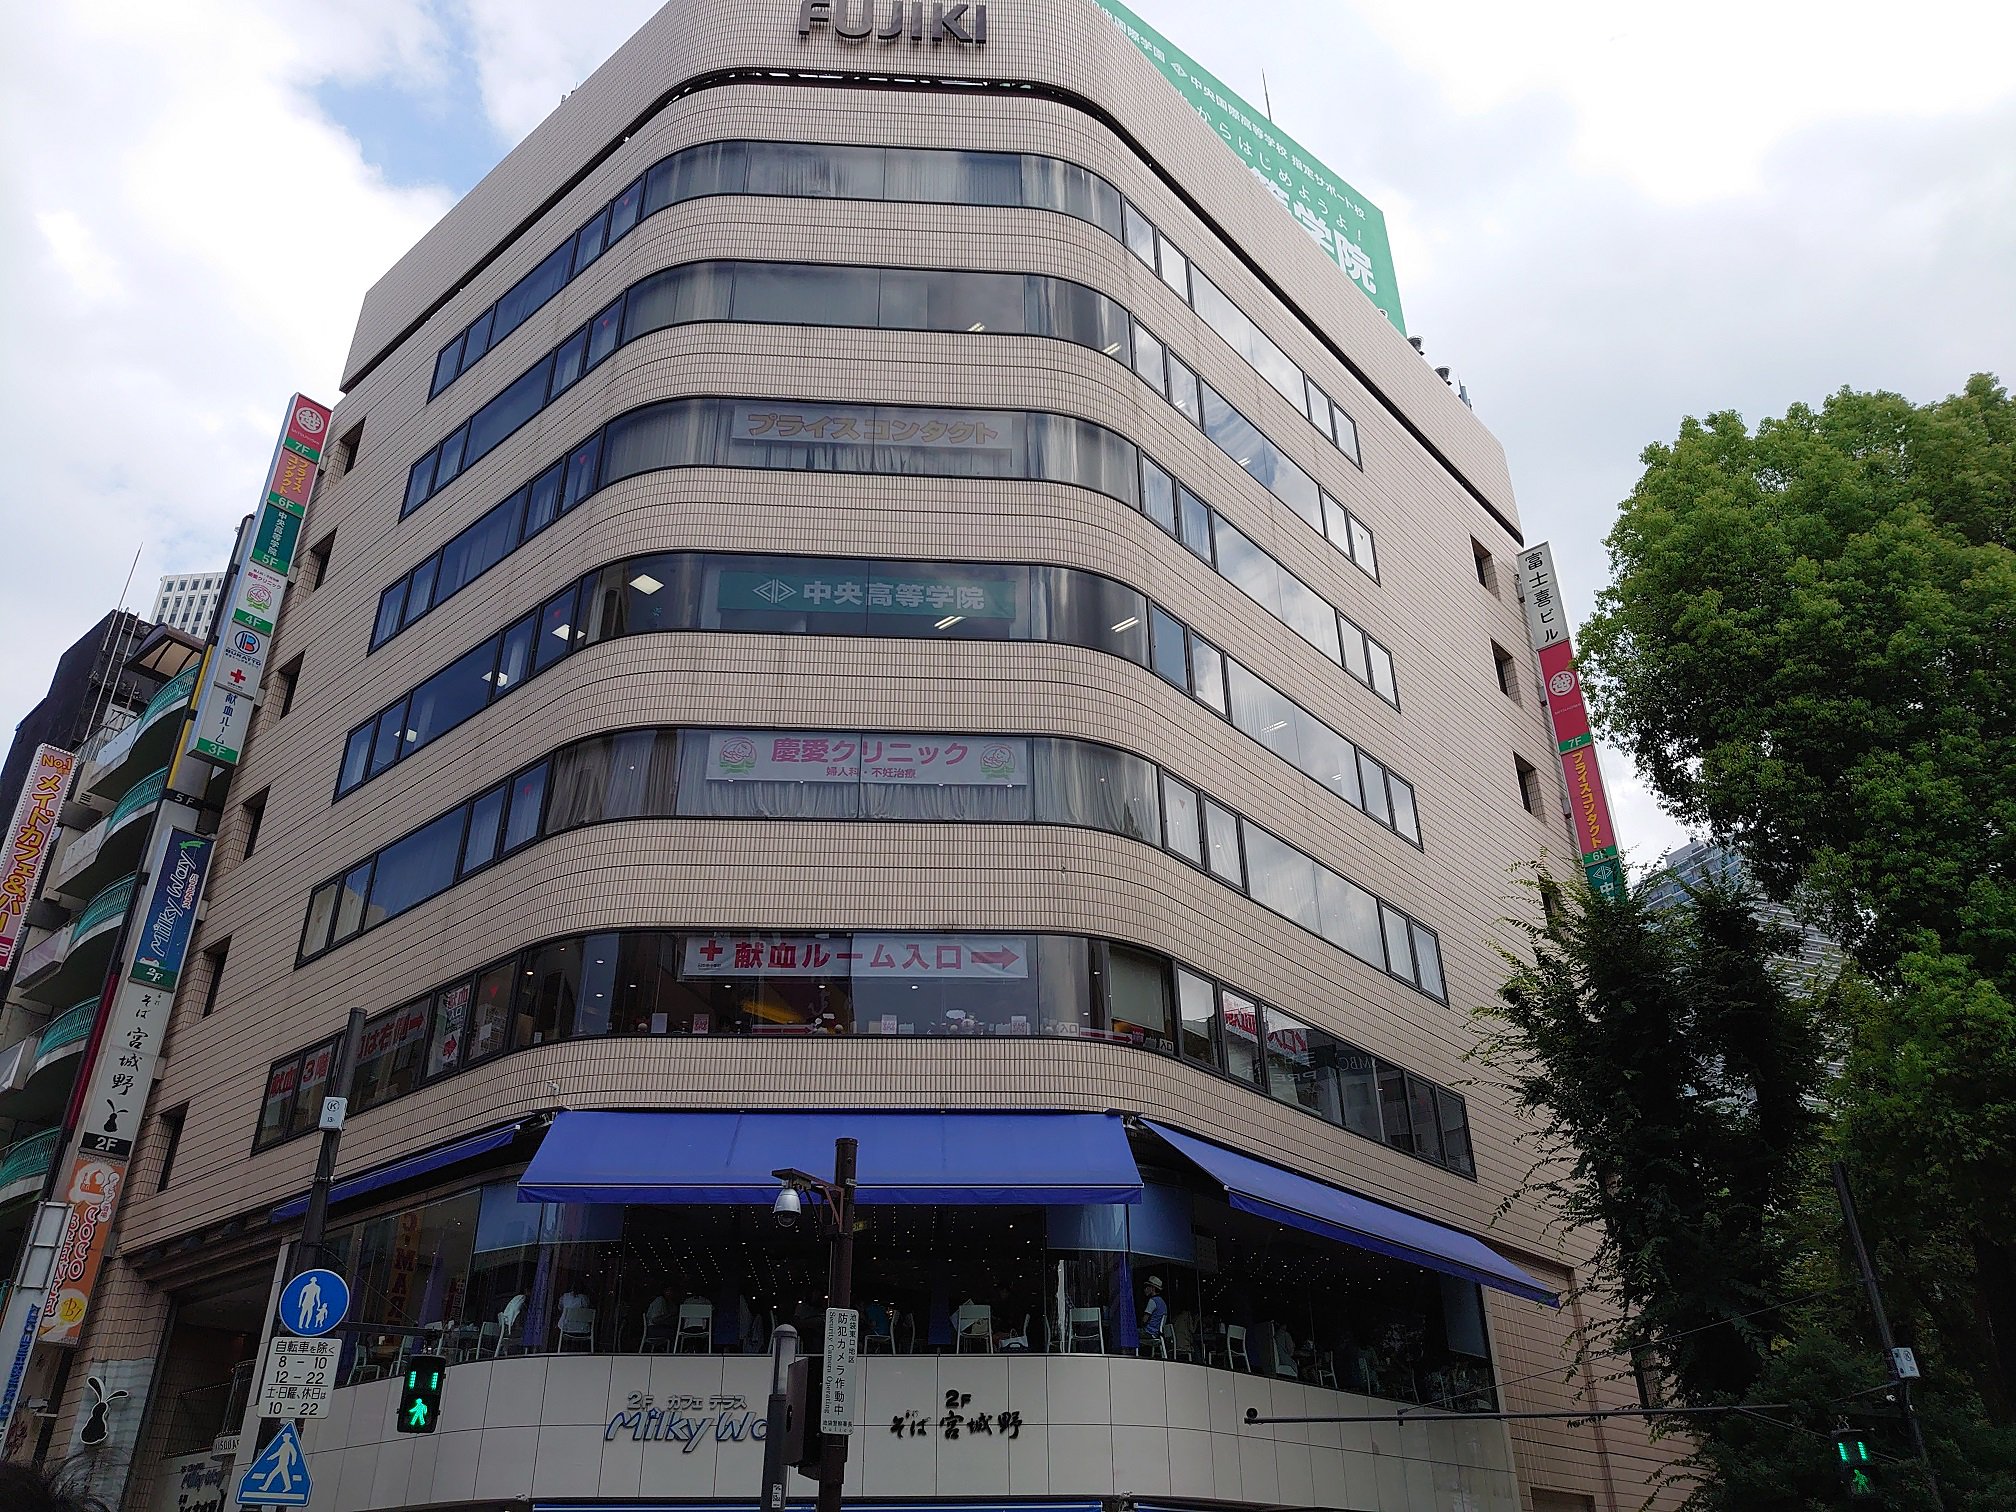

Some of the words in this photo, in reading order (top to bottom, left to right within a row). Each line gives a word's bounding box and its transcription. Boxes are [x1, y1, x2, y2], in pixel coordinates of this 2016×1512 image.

[799, 0, 987, 44] FUJIKI
[1180, 90, 1362, 241] からはじめようよ!
[748, 413, 999, 444] プライスコンタクト
[295, 441, 310, 454] 7F
[278, 498, 295, 510] 6F
[262, 555, 279, 566] 5F
[803, 580, 985, 611] 中央高等学院
[1525, 551, 1558, 642] 富士喜ビル
[245, 615, 262, 627] 4F
[215, 692, 238, 744] 献血ルーム
[208, 744, 227, 758] 3F
[1568, 736, 1581, 748] 7F
[771, 737, 969, 766] 慶愛クリニック
[42, 754, 73, 771] No.1
[151, 896, 183, 958] Milky
[734, 941, 962, 970] 献血ルーム入口
[146, 967, 163, 982] 2F
[94, 1136, 118, 1152] 2F
[276, 1340, 335, 1354] 自転車を除く
[278, 1356, 287, 1368] 8
[314, 1356, 327, 1369] 10
[834, 1312, 848, 1416] 防犯カメラ作動中
[275, 1371, 288, 1384] 12
[306, 1371, 325, 1385] 22
[628, 1391, 654, 1410] 2F
[668, 1395, 703, 1410] カフェ
[709, 1395, 748, 1410] テラス
[945, 1389, 972, 1408] 2F
[268, 1402, 281, 1415] 10
[300, 1402, 319, 1416] 22
[605, 1407, 714, 1453] Milky
